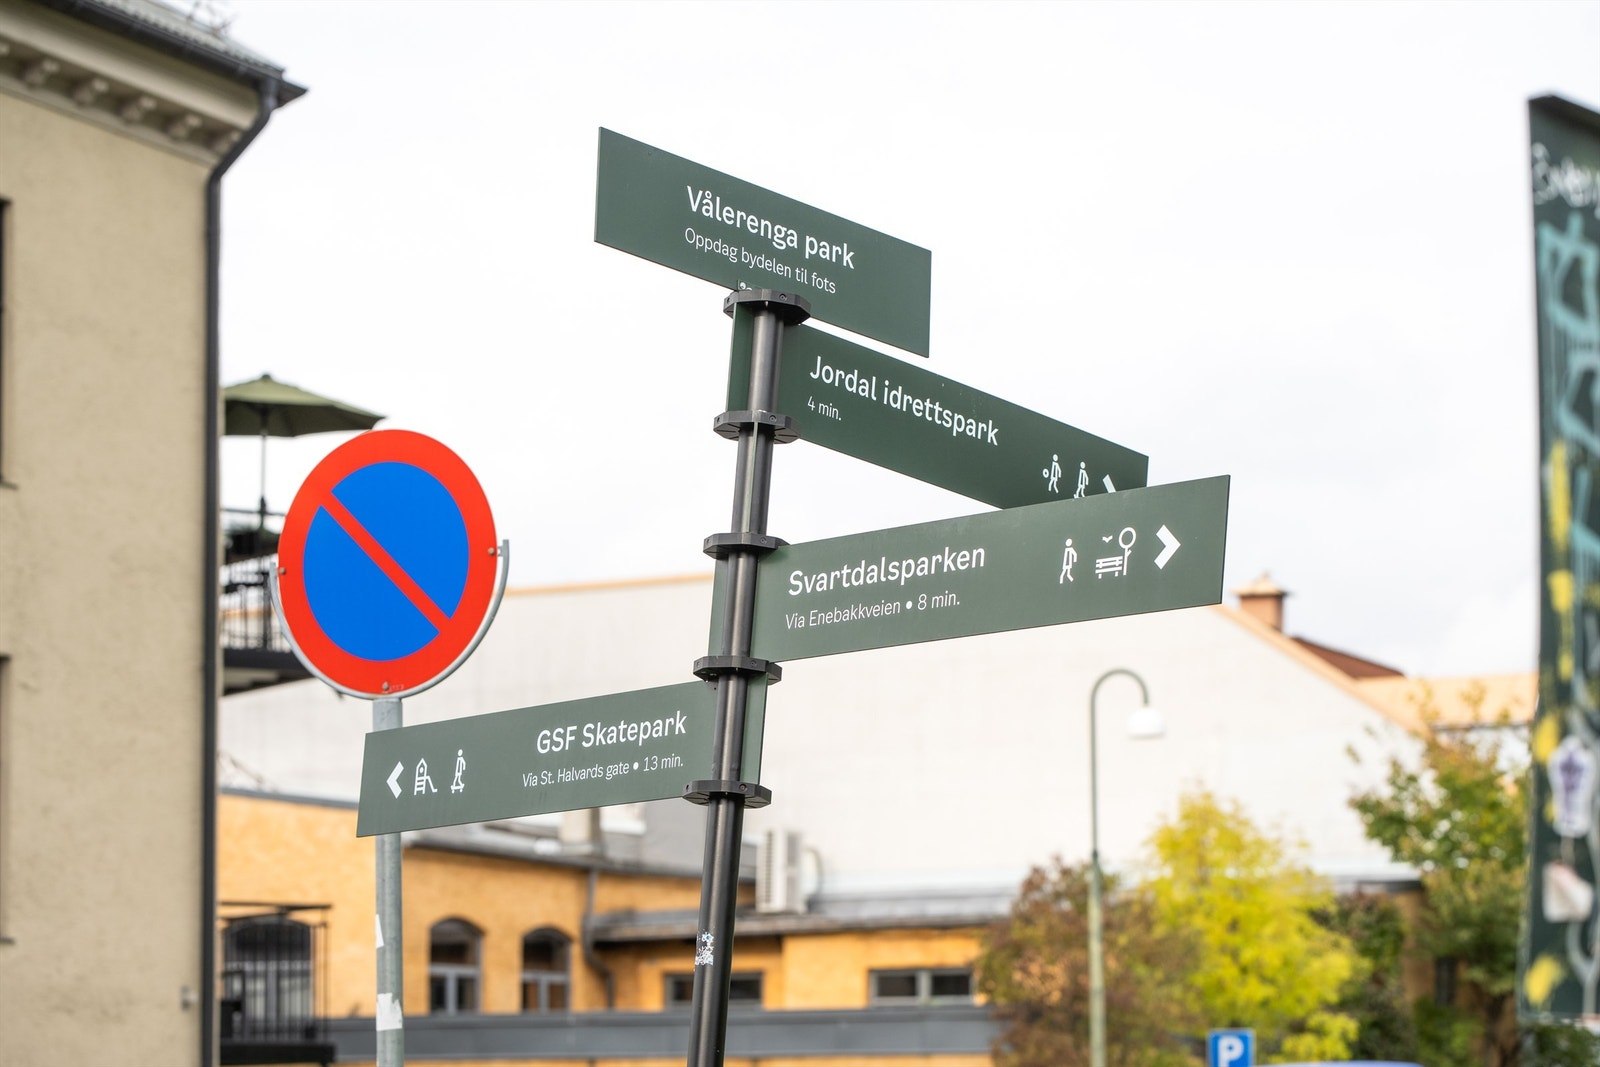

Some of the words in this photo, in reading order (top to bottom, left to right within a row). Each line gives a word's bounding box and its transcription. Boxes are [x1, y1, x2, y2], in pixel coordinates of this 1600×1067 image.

[686, 185, 798, 250] Vålerenga
[804, 235, 855, 270] park
[684, 227, 738, 263] Oppdag
[741, 246, 792, 279] bydelen
[794, 267, 809, 285] til
[811, 272, 836, 294] fots
[807, 395, 816, 411] 4
[818, 402, 842, 421] min.
[809, 355, 877, 401] Jordal
[883, 379, 999, 446] idrettspark
[788, 547, 986, 597] Svartdalsparken
[785, 611, 806, 631] Via
[808, 599, 902, 628] Enebakkveien
[916, 593, 929, 611] 8
[931, 590, 961, 610] min.
[536, 724, 578, 755] GSF
[581, 710, 688, 749] Skatepark
[521, 771, 539, 788] Via
[540, 770, 556, 786] St.
[557, 762, 605, 782] Halvards
[605, 760, 630, 781] gate
[642, 755, 660, 772] 13
[660, 752, 684, 770] min.
[1217, 1034, 1244, 1067] P
